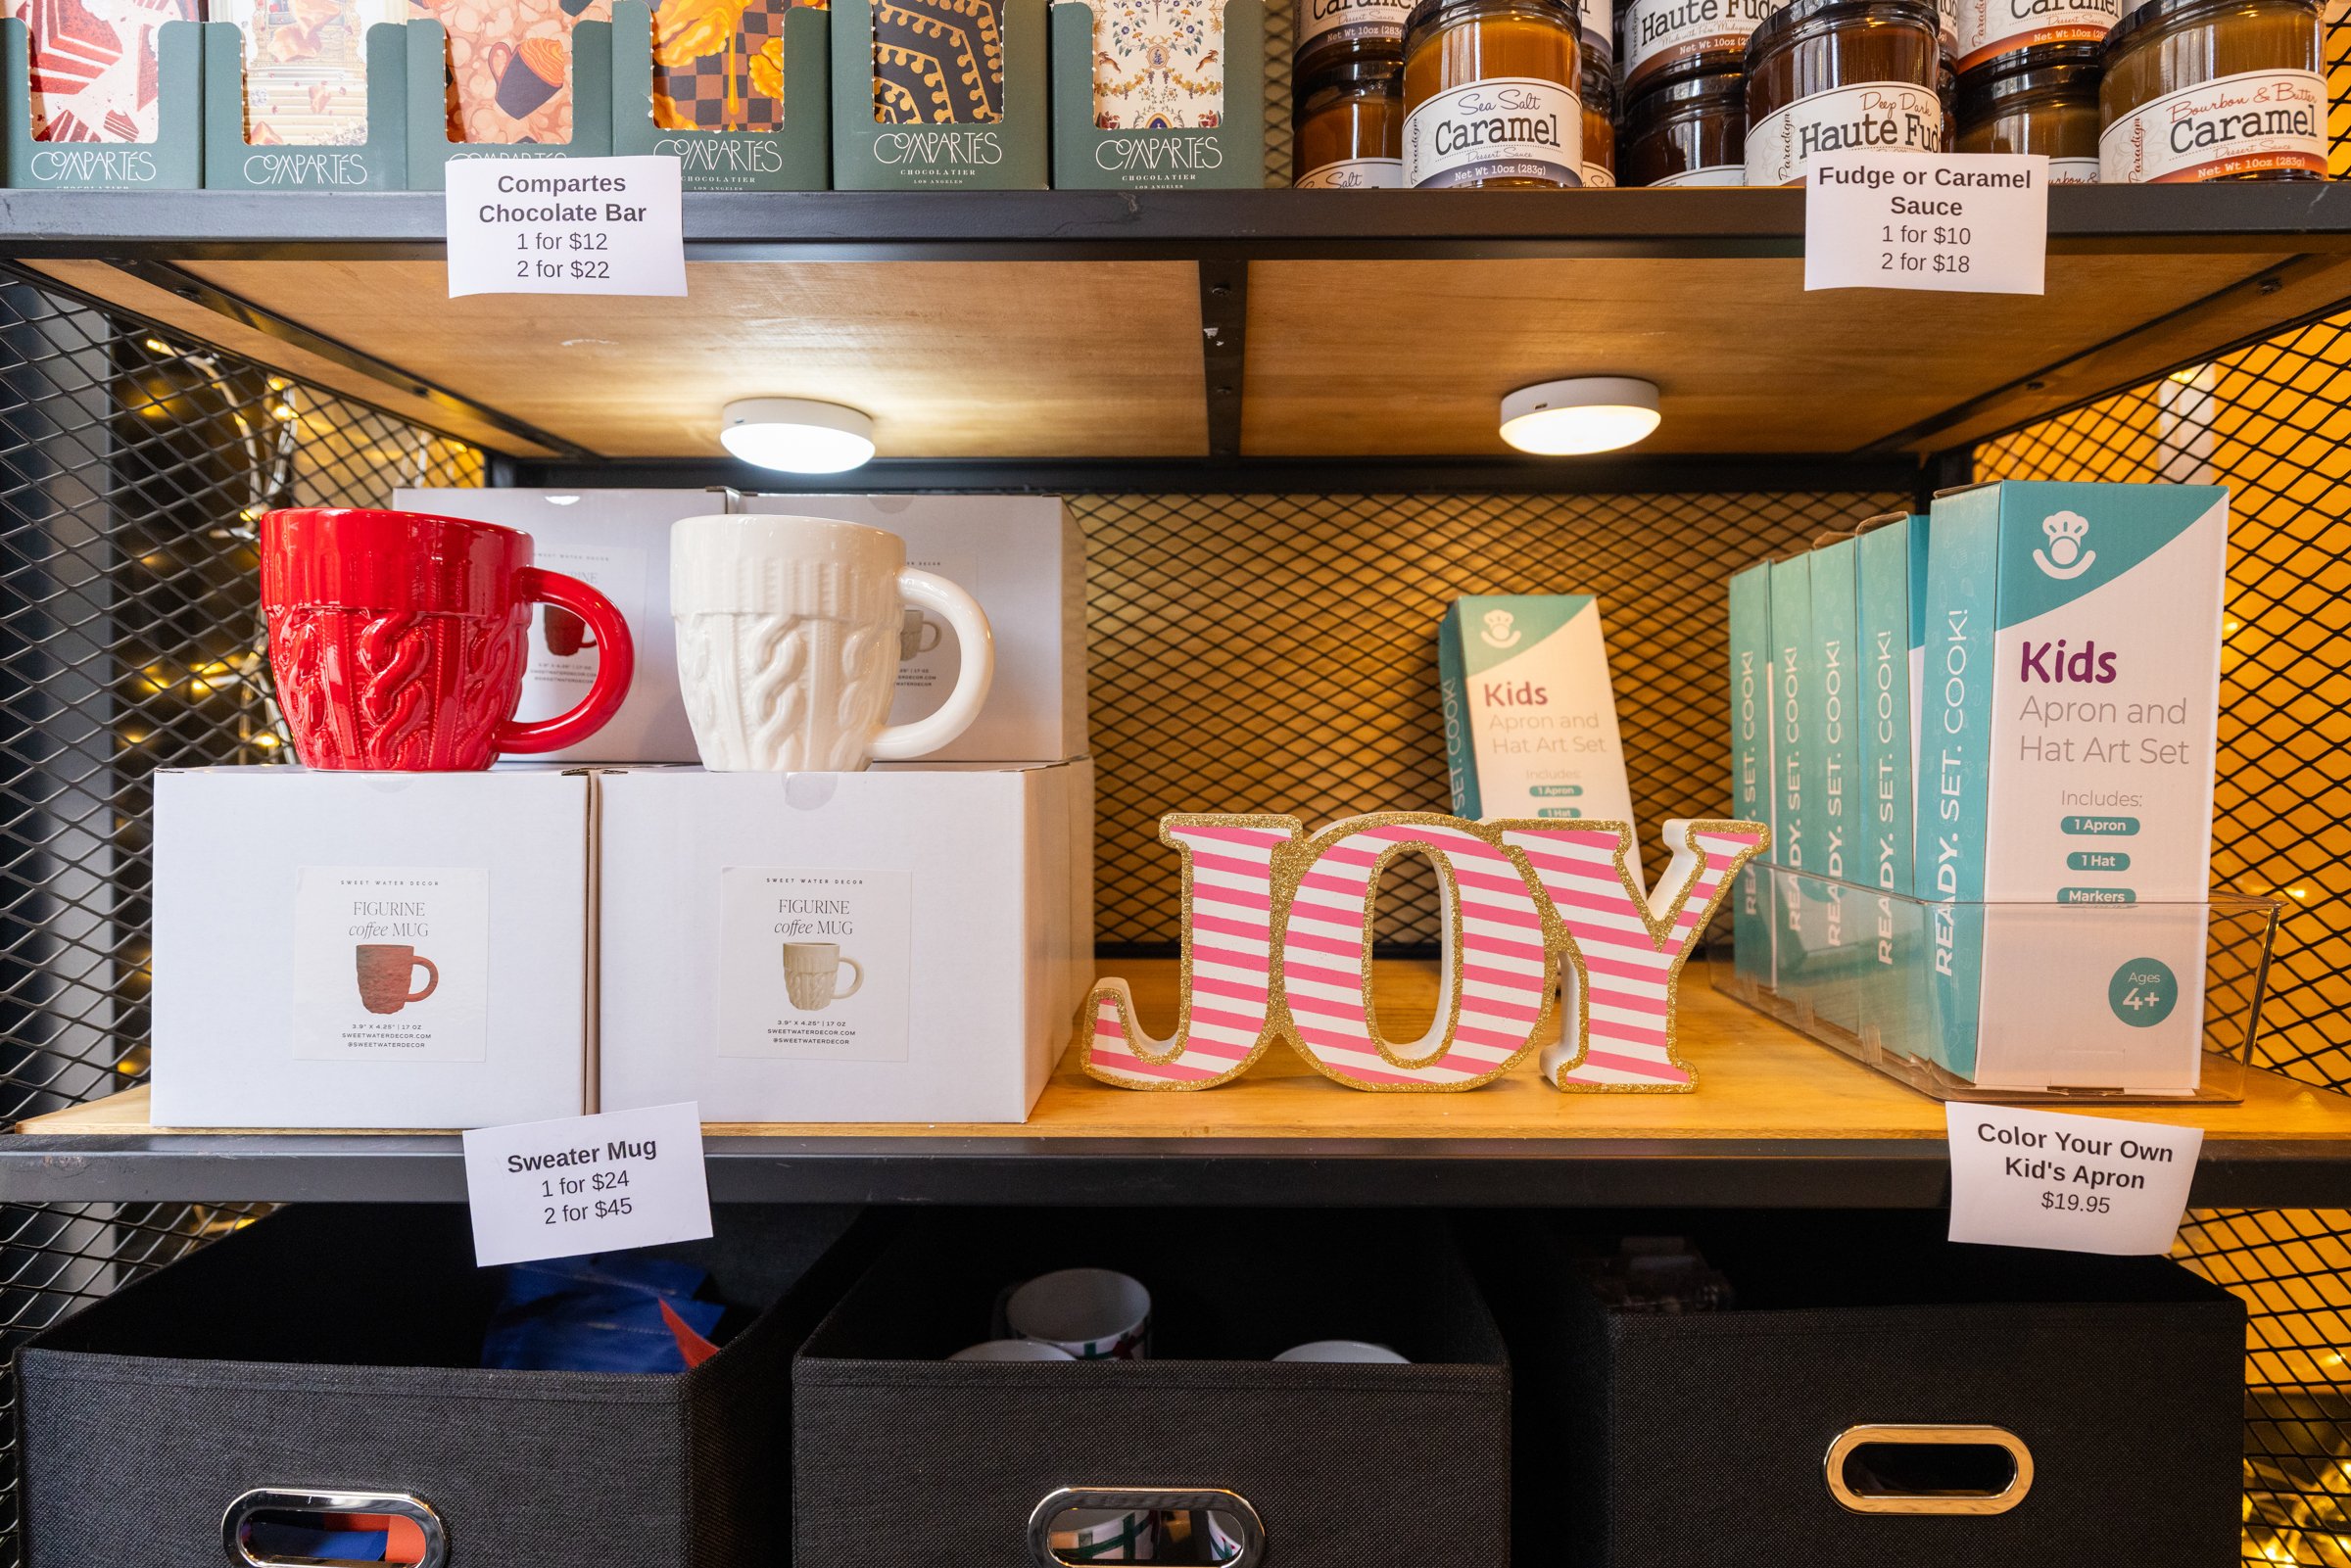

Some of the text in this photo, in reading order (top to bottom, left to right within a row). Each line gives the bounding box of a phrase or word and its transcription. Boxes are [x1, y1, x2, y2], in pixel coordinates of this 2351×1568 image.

[1327, 32, 1343, 42] Net
[1359, 25, 1379, 35] 10oz
[1680, 44, 1696, 55] Net
[1699, 41, 1712, 50] Wt
[1714, 37, 1735, 47] 10oz
[2034, 28, 2091, 43] Net Wt 10oz
[1458, 88, 1541, 116] Sea Salt
[1859, 91, 1933, 119] Deep Dark
[2166, 82, 2318, 124] Bourbon & Butter
[1435, 114, 1560, 156] Caramel
[1799, 113, 1941, 160] Haute Fud
[2170, 104, 2318, 155] Caramel
[874, 132, 1002, 165] COMPARTÉS
[1095, 136, 1223, 169] COMPARTÉS
[1410, 118, 1420, 186] Paradigm
[1466, 147, 1533, 163] Dessert Sauce
[1777, 113, 1797, 181] Paradigm
[2128, 118, 2147, 183] Paradigm
[2212, 140, 2292, 160] Dessert Sauce
[31, 150, 157, 181] COMPARTÉS
[244, 154, 368, 185] COMPARTÉS
[1454, 164, 1547, 182] Net Wt 10oz (283g)
[1819, 165, 2032, 189] Fudge or Caramel
[2197, 155, 2305, 178] Net Wt 10oz (283g)
[498, 174, 626, 197] Compartes
[479, 203, 647, 223] Chocolate Bar
[1891, 196, 1963, 216] Sauce
[517, 232, 608, 253] 1 for $12
[1882, 224, 1971, 245] 1 for $10
[516, 260, 610, 280] 2 for $22
[1881, 252, 1970, 273] 2 for $18
[2021, 639, 2117, 684] Kids
[1483, 681, 1548, 707] Kids
[1489, 713, 1599, 733] Apron and
[2019, 694, 2186, 728] Apron and
[1741, 650, 1756, 804] SET. COOK!
[1442, 676, 1465, 812] SET. COOK!
[1493, 736, 1607, 754] Hat Art Set
[2020, 735, 2189, 765] Hat Art Set
[1545, 786, 1574, 796] Apron
[1785, 646, 1802, 931] READY. SET. COOK!
[1826, 640, 1843, 948] READY. SET. COOK!
[1878, 630, 1895, 965] READY. SET. COOK!
[1936, 608, 1969, 976] READY. SET. COOK!
[2061, 789, 2143, 808] Includes:
[2075, 820, 2127, 833] 1 Apron
[2082, 855, 2116, 867] 1 Hat
[354, 901, 425, 917] FIGURINE
[779, 899, 850, 915] FIGURINE
[2069, 890, 2126, 903] Markers
[349, 921, 428, 940] coffee MUG
[774, 919, 853, 937] coffee MUG
[1080, 811, 1771, 1093] JOY
[2128, 972, 2161, 985] Ages
[2122, 987, 2160, 1011] 4+
[1977, 1122, 2174, 1163] Color Your Own
[506, 1139, 657, 1173] Sweater Mug
[542, 1169, 630, 1197] 1 for $24
[2005, 1157, 2145, 1190] Kid's Apron
[545, 1197, 633, 1224] 2 for $45
[2040, 1191, 2111, 1214] $19.95
